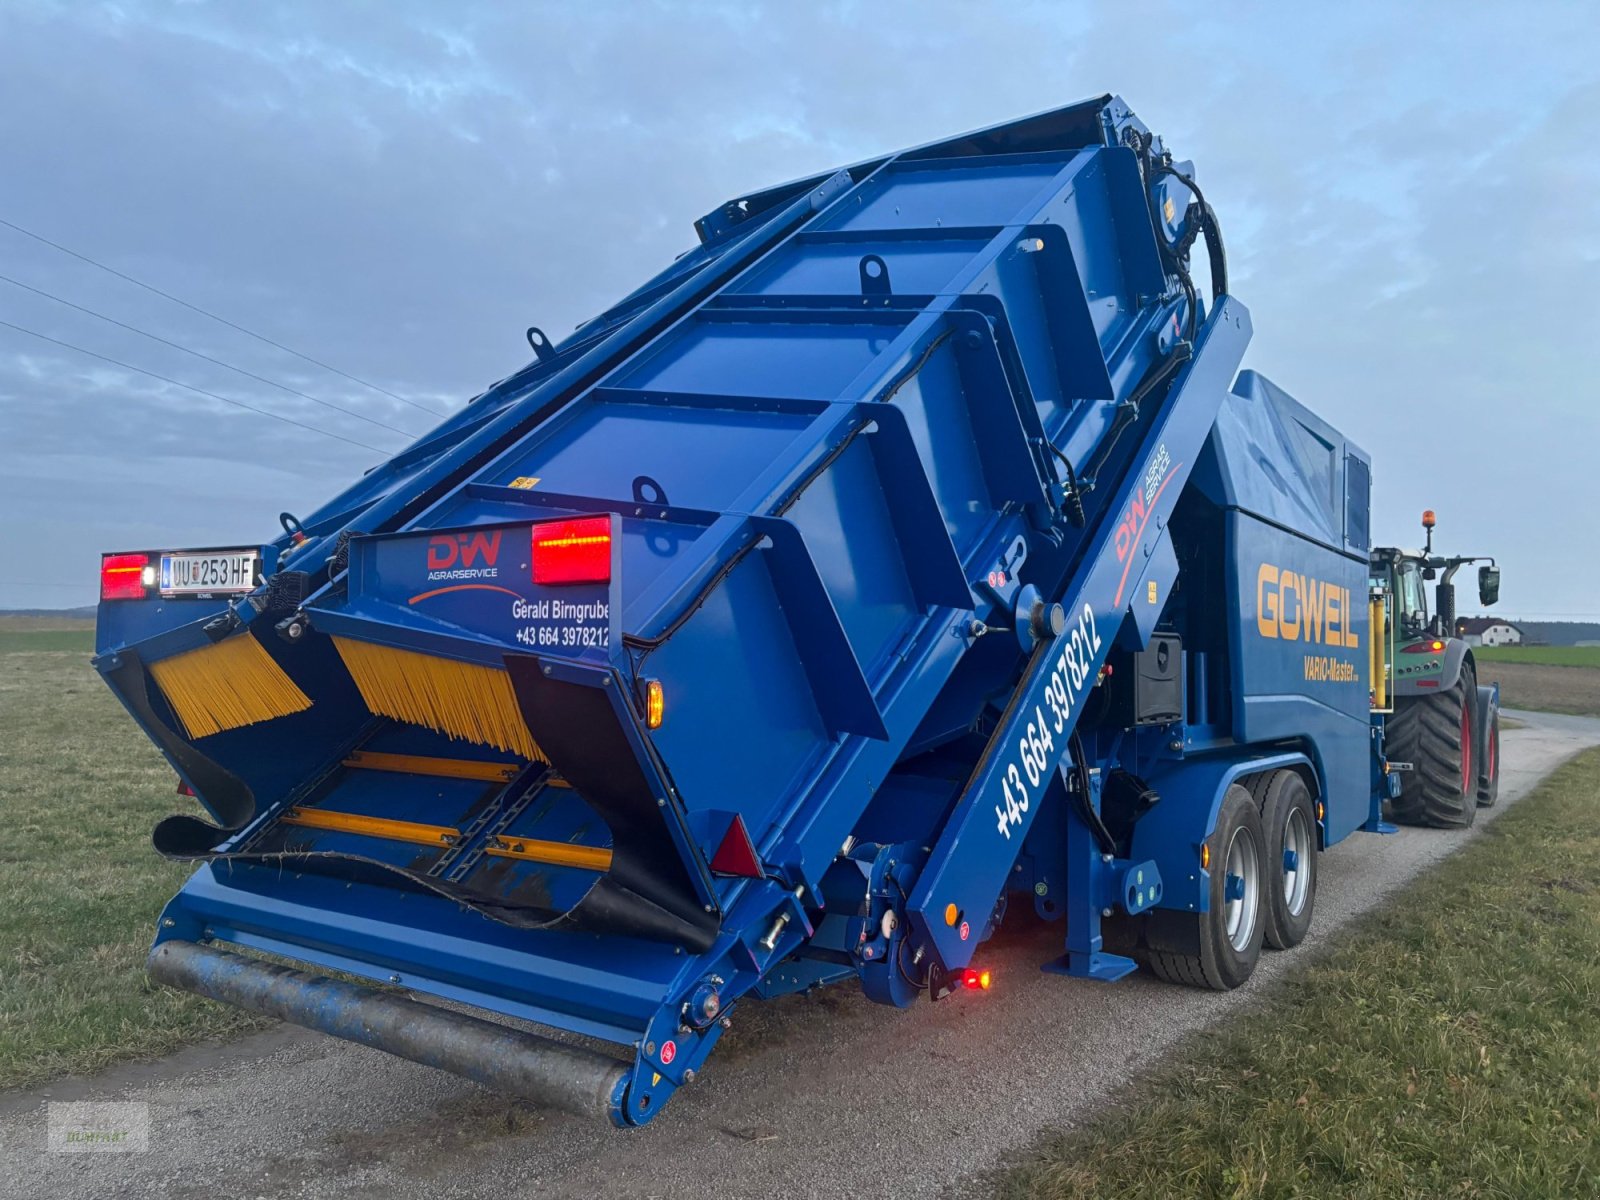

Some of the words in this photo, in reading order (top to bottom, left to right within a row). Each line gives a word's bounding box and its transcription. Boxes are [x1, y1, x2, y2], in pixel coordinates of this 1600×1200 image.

[1145, 443, 1166, 489] AGRAR
[1146, 451, 1171, 505] SERVICE
[173, 560, 190, 586] UU
[201, 558, 228, 585] 253
[232, 557, 250, 585] HF
[428, 568, 498, 581] AGRARSERVICE
[512, 600, 549, 619] Gerald
[516, 626, 536, 646] +43
[539, 626, 559, 646] 664
[562, 626, 609, 647] 3978212
[1304, 655, 1354, 682] VARIO-Master
[995, 763, 1029, 840] +43
[1020, 705, 1054, 788] 664
[1045, 602, 1102, 734] 3978212
